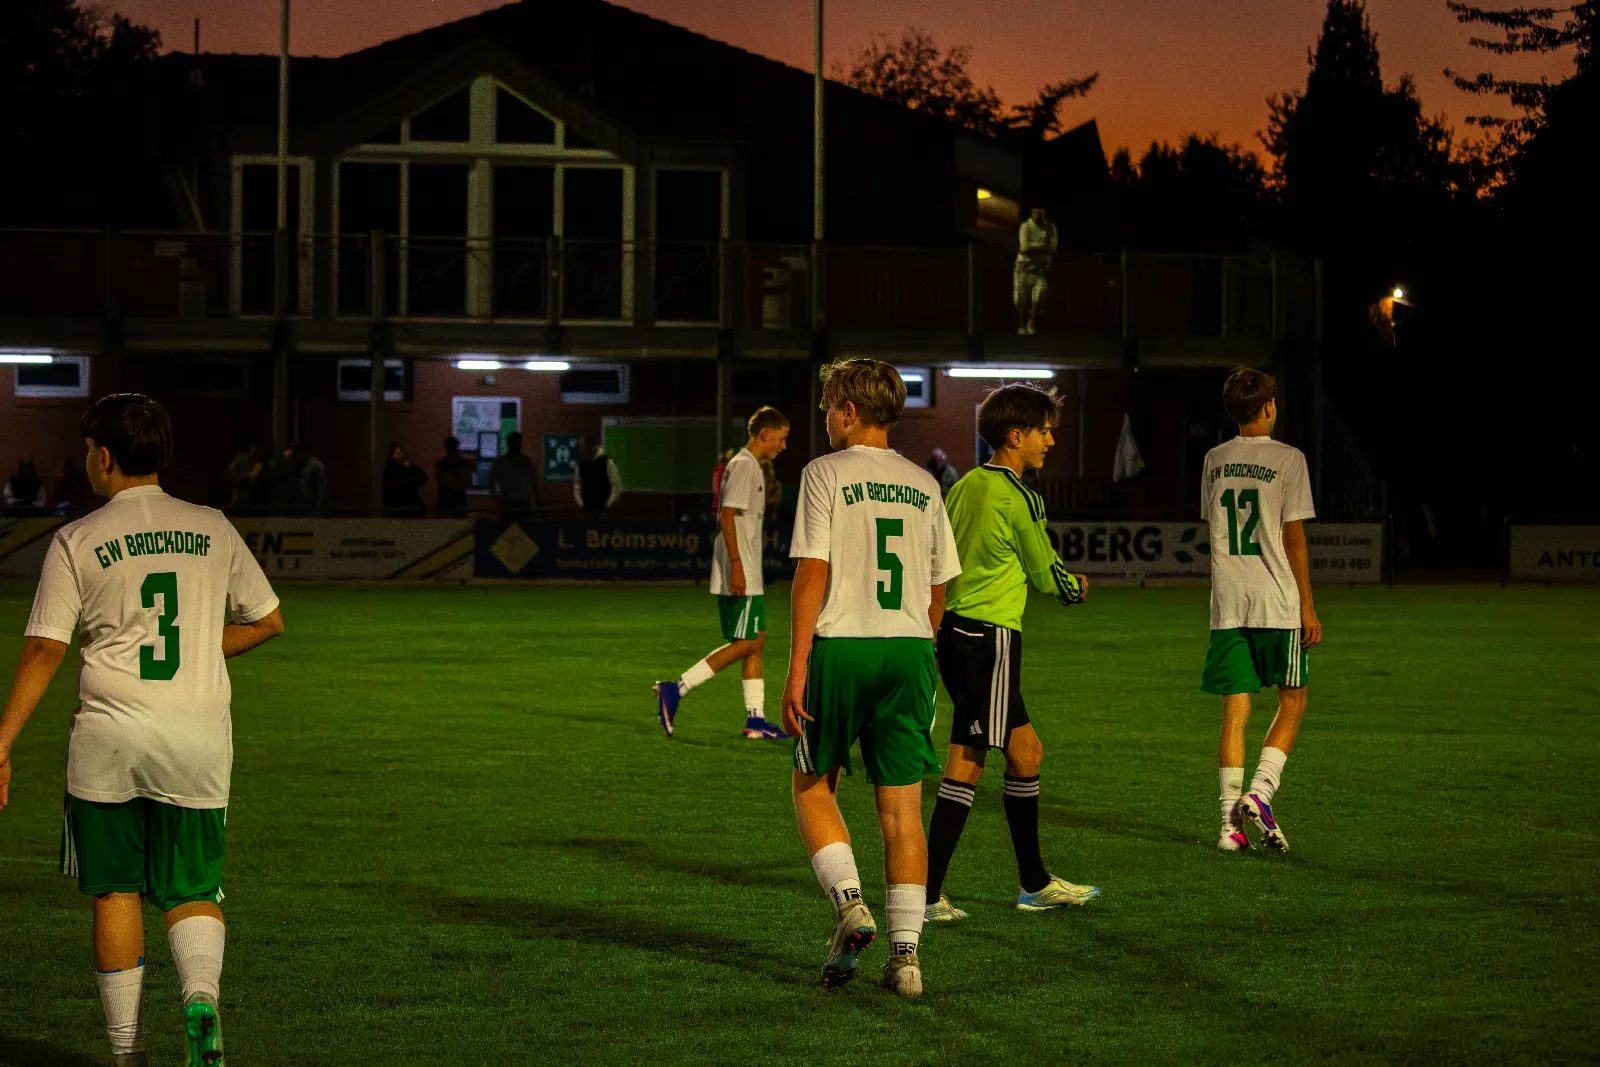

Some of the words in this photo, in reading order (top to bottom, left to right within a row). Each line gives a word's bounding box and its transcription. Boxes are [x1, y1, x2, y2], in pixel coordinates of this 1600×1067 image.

[842, 483, 864, 506] GW
[866, 482, 930, 512] BROCKDORF
[1224, 464, 1277, 483] BROCKDORF
[1220, 489, 1262, 555] 12
[94, 539, 123, 569] GW
[124, 531, 210, 556] BROCKDORF
[876, 518, 903, 610] 5
[140, 572, 180, 680] 3
